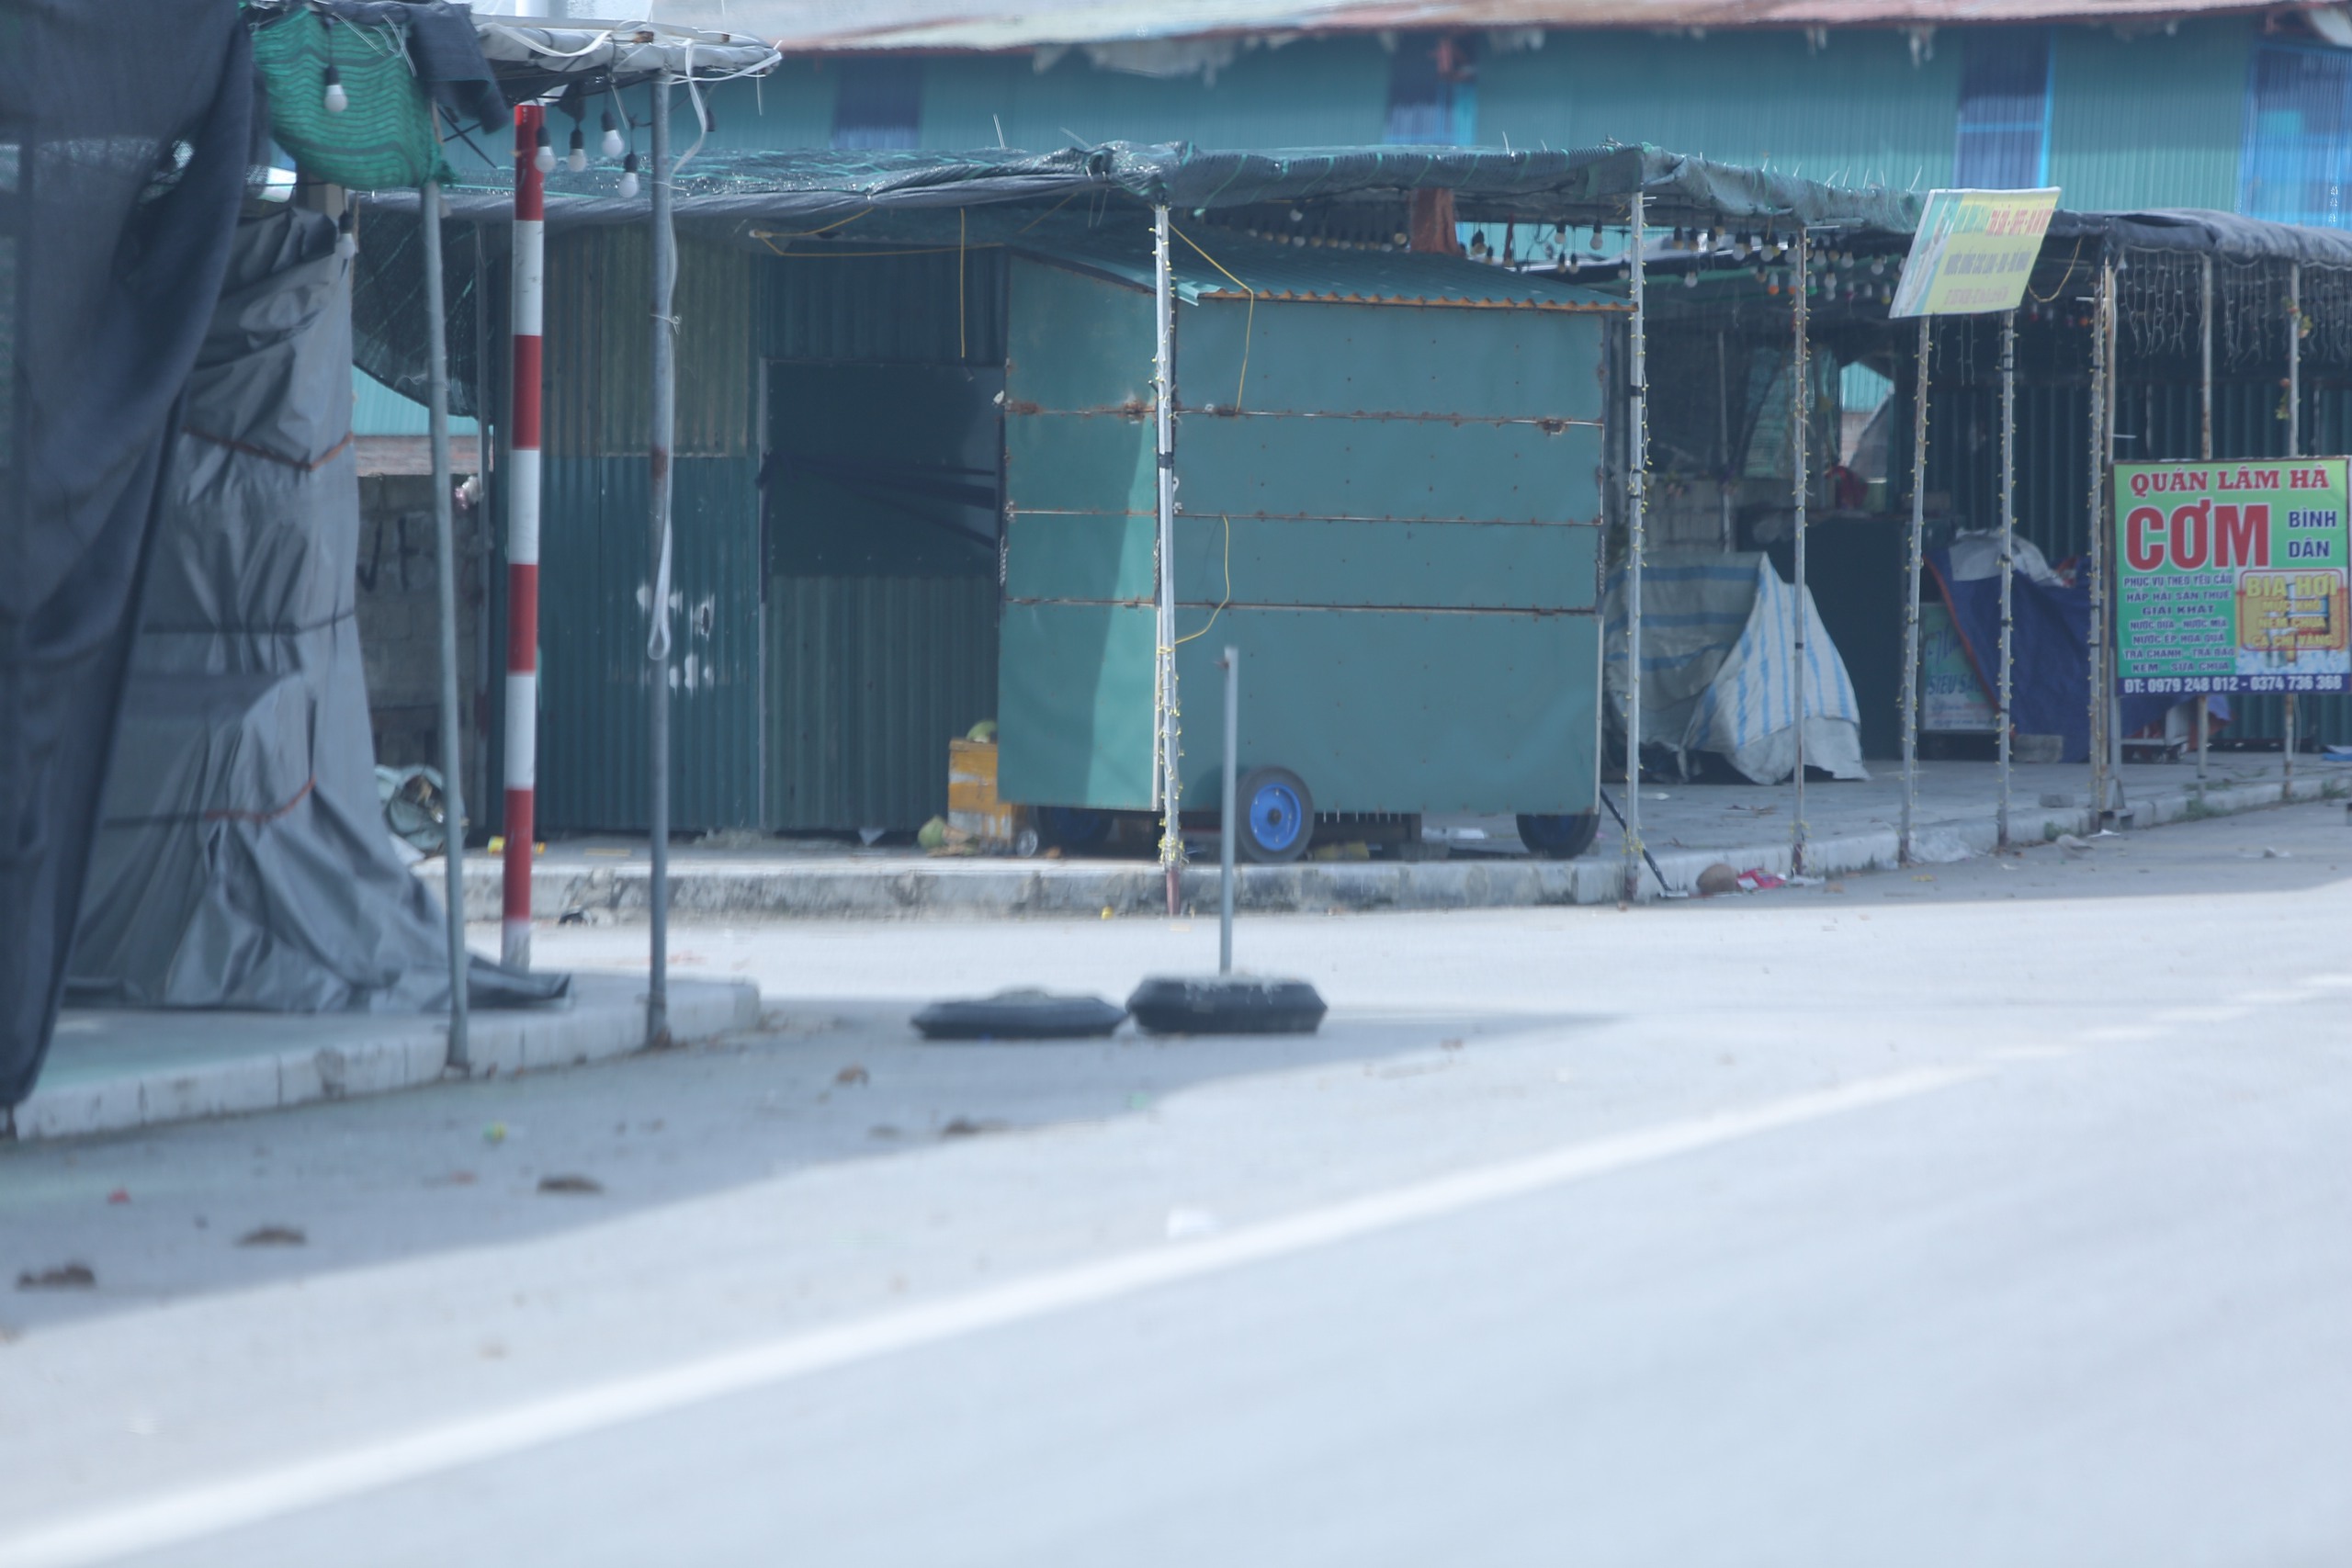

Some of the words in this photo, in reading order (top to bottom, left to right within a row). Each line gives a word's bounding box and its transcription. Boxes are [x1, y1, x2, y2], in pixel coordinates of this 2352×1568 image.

[2130, 468, 2208, 497] QUÁN
[2217, 467, 2279, 490] LÂM
[2290, 465, 2330, 489] HÀ
[2289, 510, 2336, 528] BÌNH
[2126, 499, 2269, 570] CƠM
[2289, 536, 2330, 558] DÂN
[2246, 575, 2287, 597] BIA
[2295, 573, 2338, 596] HƠI
[2132, 663, 2159, 672] KEM
[2124, 679, 2145, 694] ĐT:
[2148, 678, 2181, 693] 0979
[2184, 677, 2211, 692] 248
[2212, 677, 2238, 692] 012
[2250, 676, 2284, 691] 0374
[2288, 675, 2313, 690] 736
